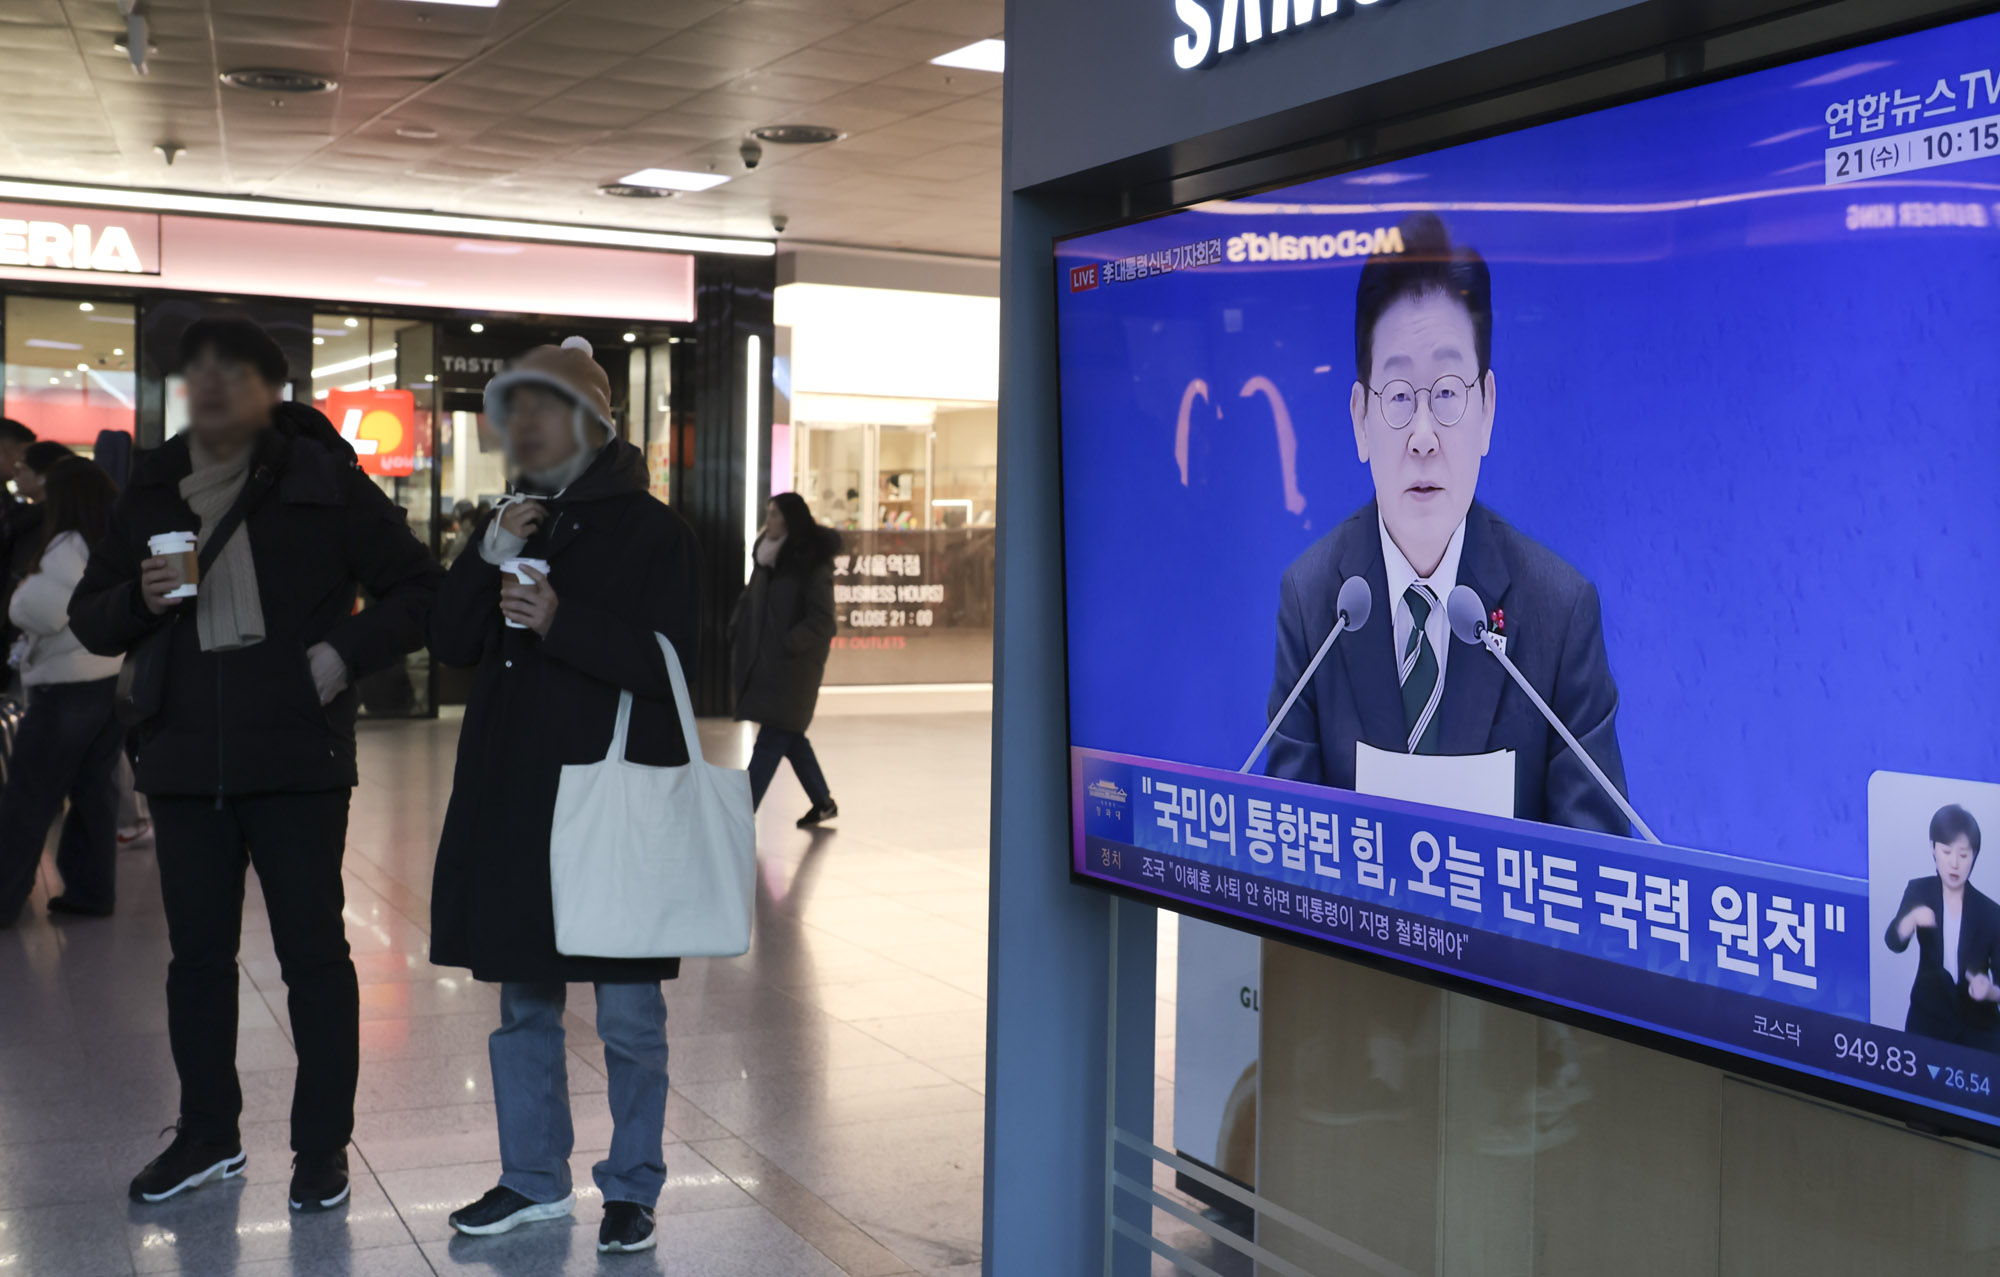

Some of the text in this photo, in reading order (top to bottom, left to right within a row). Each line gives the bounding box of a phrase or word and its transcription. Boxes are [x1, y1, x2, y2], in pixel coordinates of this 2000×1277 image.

[1923, 122, 1999, 161] 10:15
[1073, 268, 1095, 288] LIVE
[1101, 848, 1121, 870] 정치
[1142, 775, 1845, 990] "국민의 통합된 힘, 오늘 만든 국력 원천"
[1142, 856, 1166, 883] 조국
[1215, 874, 1241, 903] 사퇴
[1245, 881, 1259, 907] 안
[1263, 886, 1291, 916] 하면
[1295, 894, 1354, 933] 대통령이
[1359, 910, 1390, 941] 지명
[1753, 1014, 1991, 1097] 코스닥 949.83 26.54
